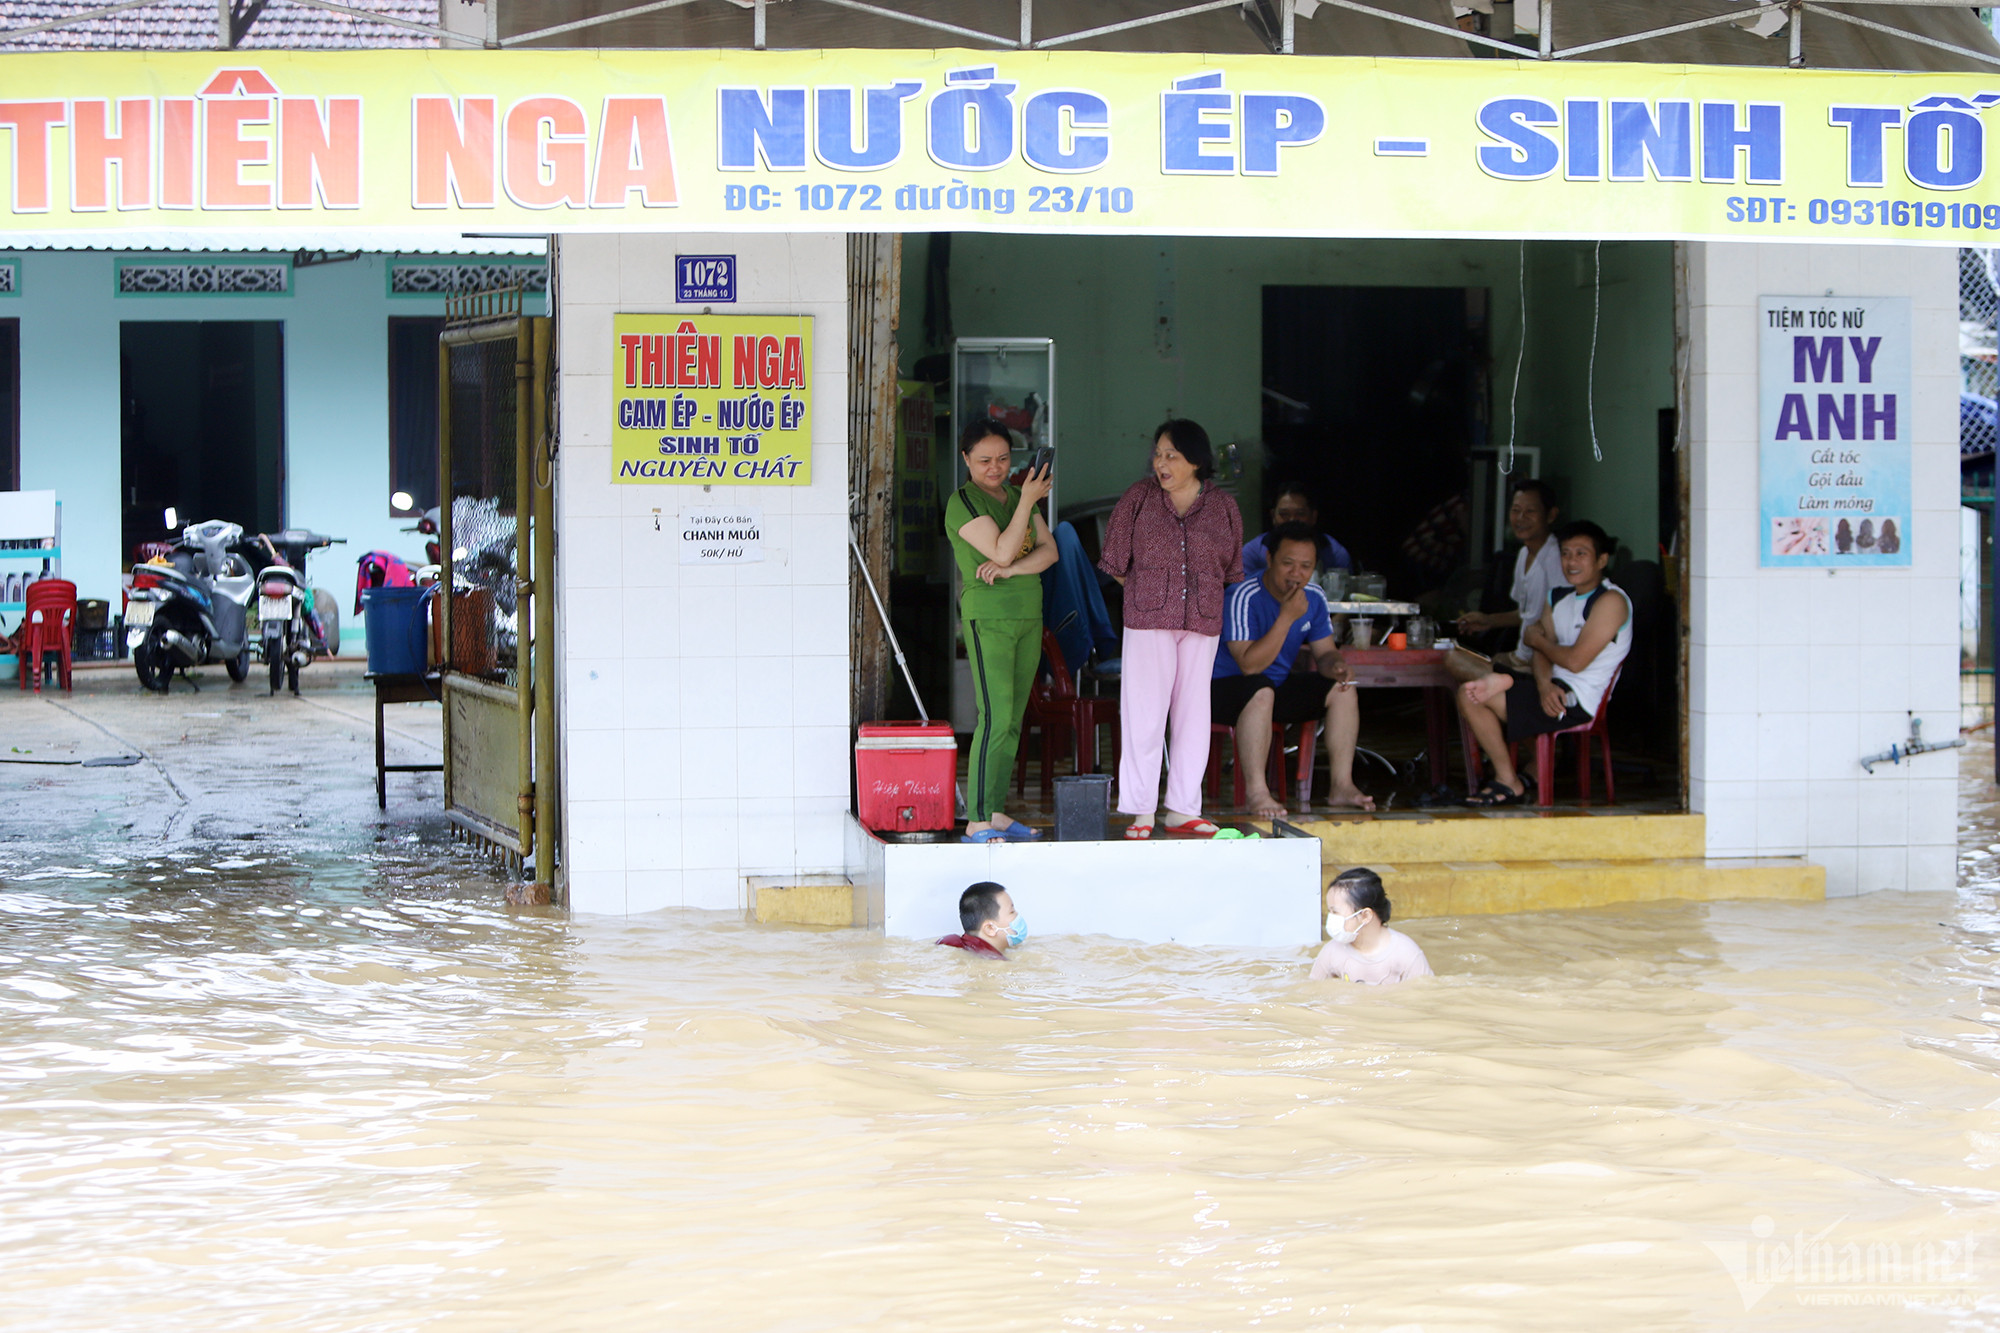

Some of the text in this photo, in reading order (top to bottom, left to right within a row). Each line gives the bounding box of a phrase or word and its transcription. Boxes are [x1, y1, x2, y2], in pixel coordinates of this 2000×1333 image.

[0, 66, 362, 213] THIÊN
[411, 94, 682, 210] NGA
[717, 63, 1113, 174] NƯỚC
[1160, 69, 1328, 177] ÉP
[1476, 95, 1785, 185] SINH
[1828, 90, 2000, 191] TỐ
[724, 177, 1134, 214] ĐC: 1072 đường 23/10
[1727, 196, 2000, 231] SĐT: 0931619109
[684, 260, 728, 286] 1072
[684, 287, 728, 298] 23 THÁNG 10
[1768, 306, 1865, 332] TIỆM TÓC NỮ
[620, 320, 805, 389] THIÊN NGA
[1794, 336, 1882, 383] MY
[618, 399, 666, 429] CAM
[672, 392, 697, 429] ÉP
[718, 392, 774, 430] NƯỚC
[780, 393, 805, 430] ÉP
[1775, 393, 1897, 441] ANH
[659, 433, 763, 455] SINH TỐ
[1811, 447, 1861, 464] Cắt tóc
[619, 454, 804, 479] NGUYÊN CHẤT
[1809, 470, 1863, 490] Gội đầu
[1799, 496, 1874, 512] Làm móng
[683, 525, 760, 540] CHANH MUỐI
[690, 516, 703, 525] Tại
[736, 516, 752, 524] Bán
[727, 546, 743, 557] HỦ
